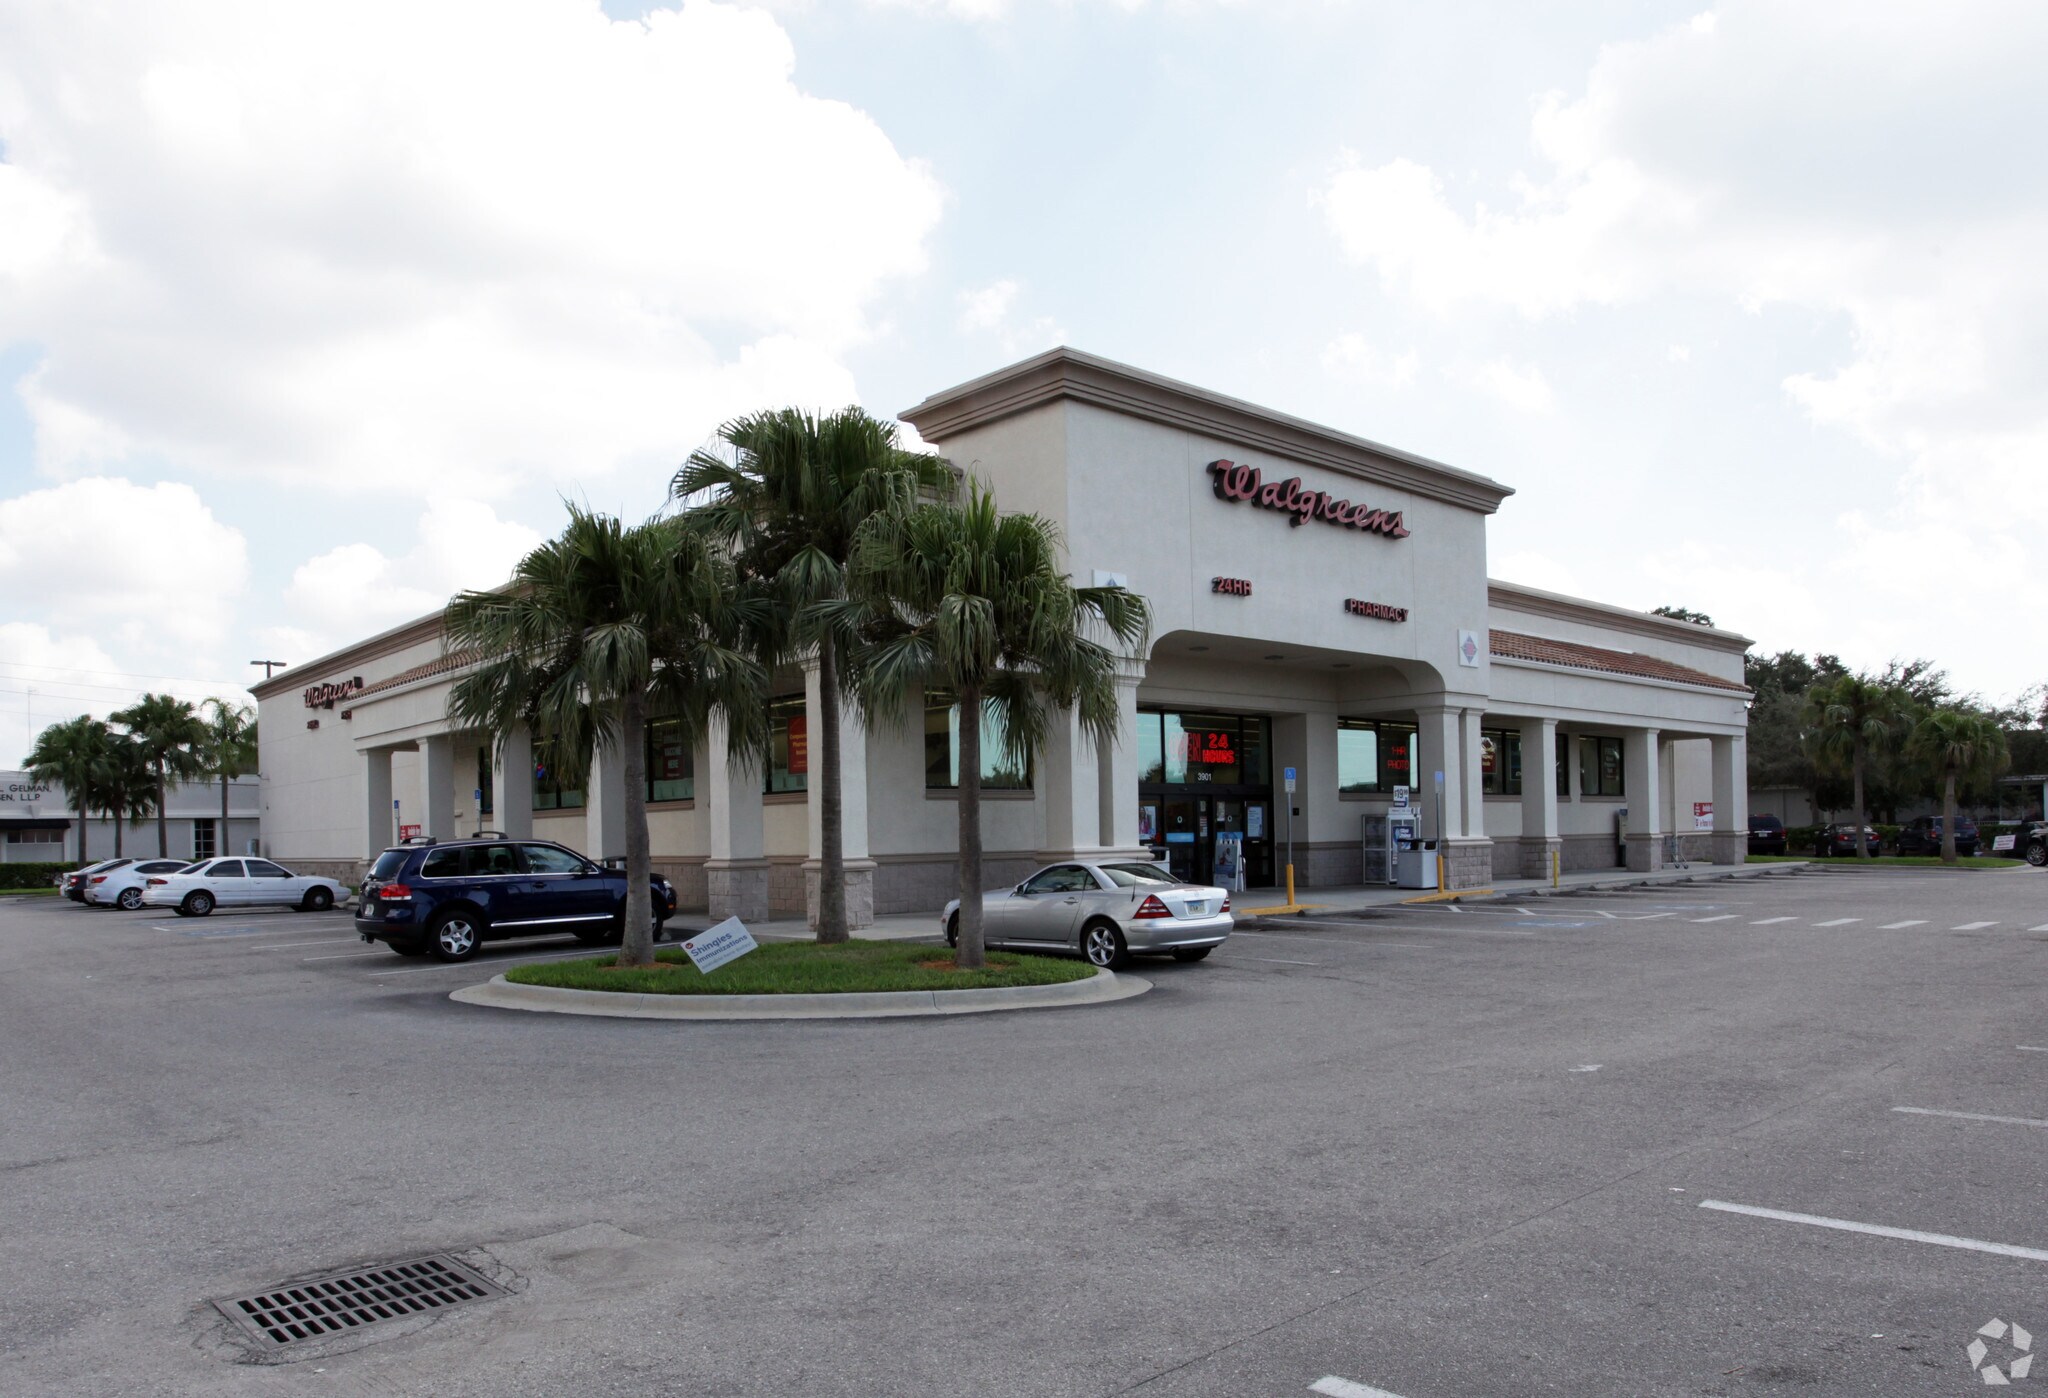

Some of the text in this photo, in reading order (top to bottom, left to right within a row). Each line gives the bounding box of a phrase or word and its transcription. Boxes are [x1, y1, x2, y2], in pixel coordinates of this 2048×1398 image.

[1210, 459, 1410, 538] Walgreens
[1216, 576, 1253, 596] 24HR
[1348, 600, 1409, 621] PHARMACY
[1208, 732, 1228, 749] 24
[1203, 749, 1235, 764] HOURS
[1387, 760, 1409, 769] PHOTO
[1197, 772, 1212, 781] 3901
[691, 933, 732, 957] Shingles
[696, 935, 748, 964] Immunizations
